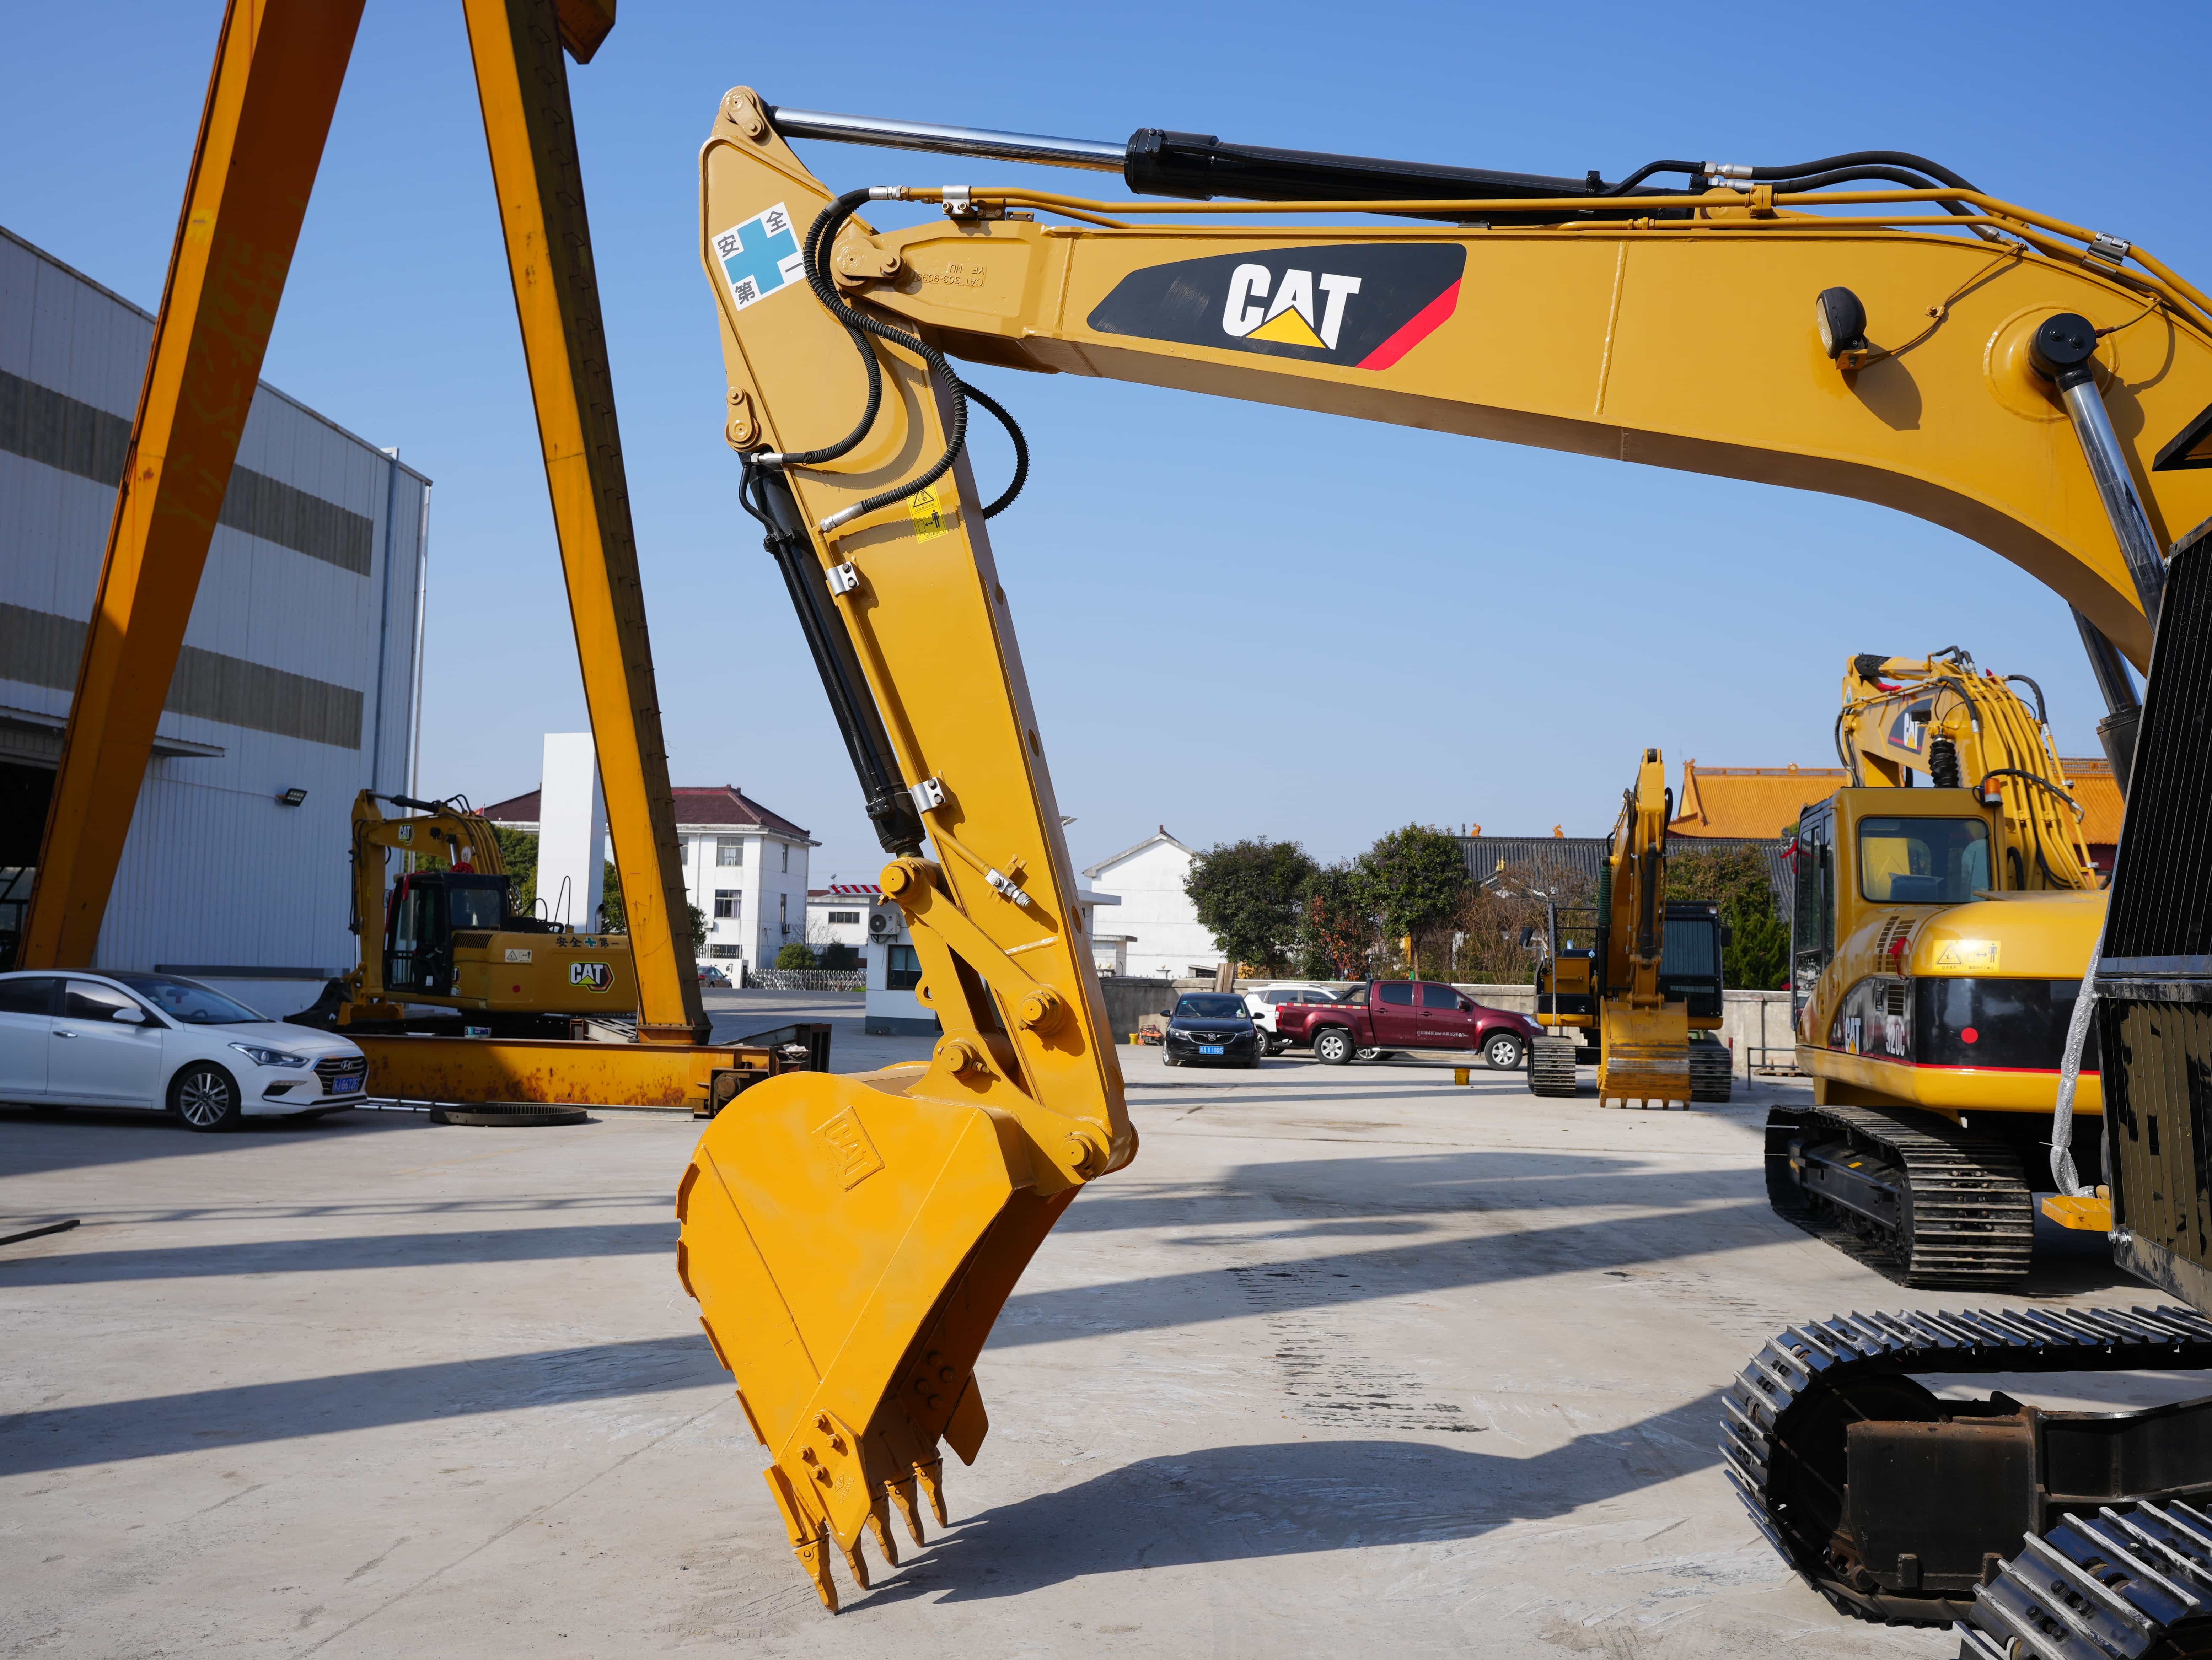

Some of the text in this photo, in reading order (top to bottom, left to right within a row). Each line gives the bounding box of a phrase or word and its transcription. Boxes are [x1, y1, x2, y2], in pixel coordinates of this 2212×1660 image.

[963, 277, 984, 287] CAT
[1222, 263, 1362, 350] CAT
[399, 825, 411, 840] CAT
[555, 936, 620, 948] 安全 第一
[570, 963, 603, 985] CAT
[1845, 1017, 1861, 1055] CAT
[1886, 1023, 1905, 1056] 320C
[825, 1119, 873, 1176] CAT
